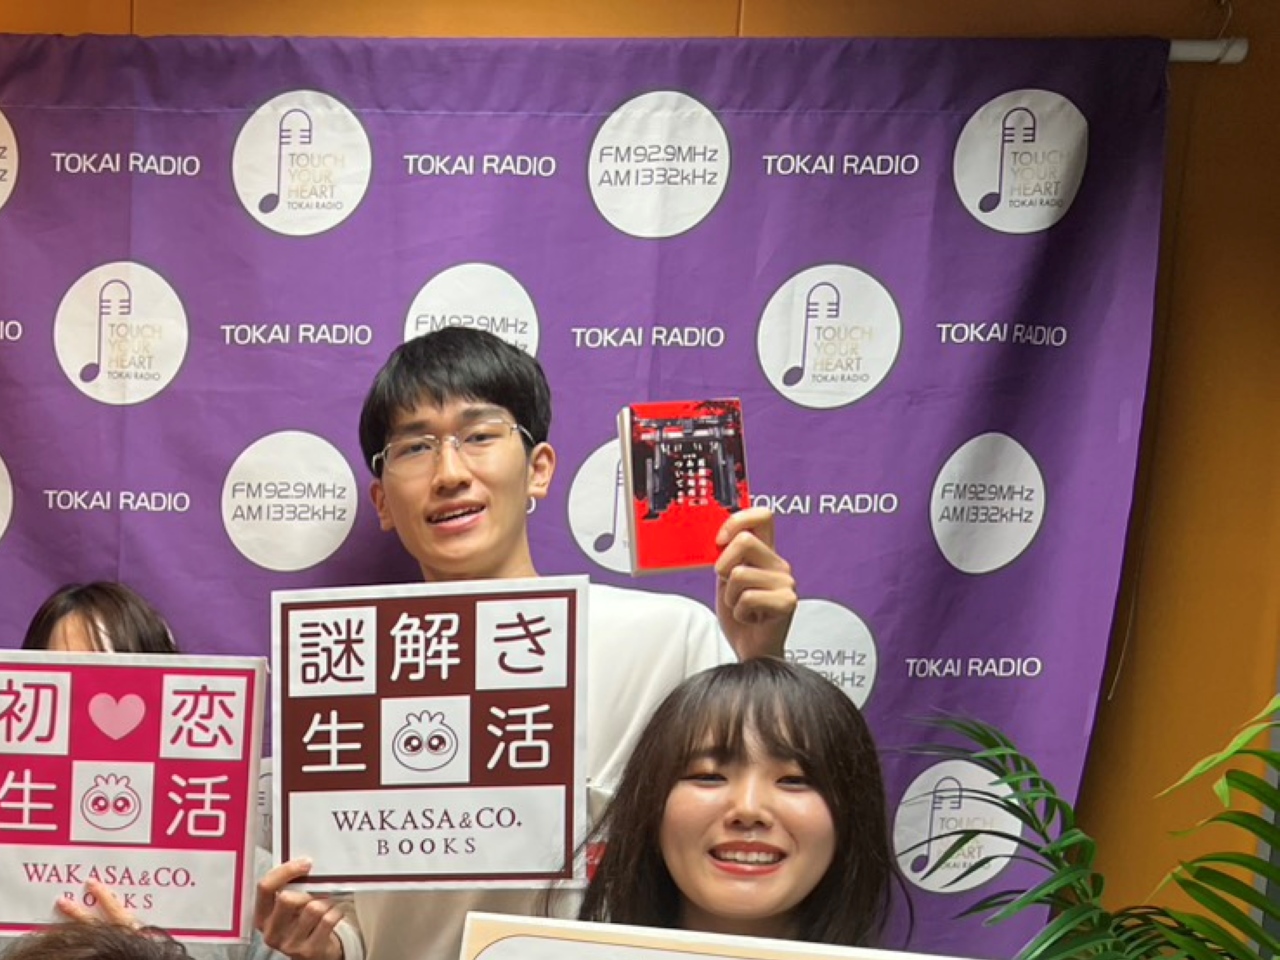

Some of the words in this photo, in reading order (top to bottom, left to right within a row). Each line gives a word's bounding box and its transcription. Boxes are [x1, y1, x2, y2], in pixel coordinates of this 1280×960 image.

[50, 152, 121, 174] TOKAI
[129, 152, 201, 176] RADIO
[403, 154, 474, 175] TOKAI
[482, 154, 556, 177] RADIO
[762, 154, 834, 175] TOKAI
[843, 154, 920, 175] RADIO
[288, 184, 334, 198] HEART
[1010, 181, 1061, 196] HEART
[220, 324, 291, 345] TOKAI
[298, 324, 372, 345] RADIO
[571, 326, 643, 348] TOKAI
[651, 326, 725, 347] RADIO
[935, 321, 1009, 345] TOKAI
[1011, 322, 1068, 348] RADIO
[110, 355, 153, 369] HEART
[814, 357, 863, 372] HEART
[44, 489, 111, 510] TOKAI
[119, 491, 190, 512] RADIO
[749, 494, 811, 514] OKAI
[819, 492, 899, 513] RADIO
[905, 658, 962, 678] TOKAI
[968, 657, 1042, 677] RADIO
[331, 806, 523, 832] WAKASA&CO.
[376, 836, 476, 855] BOOKS
